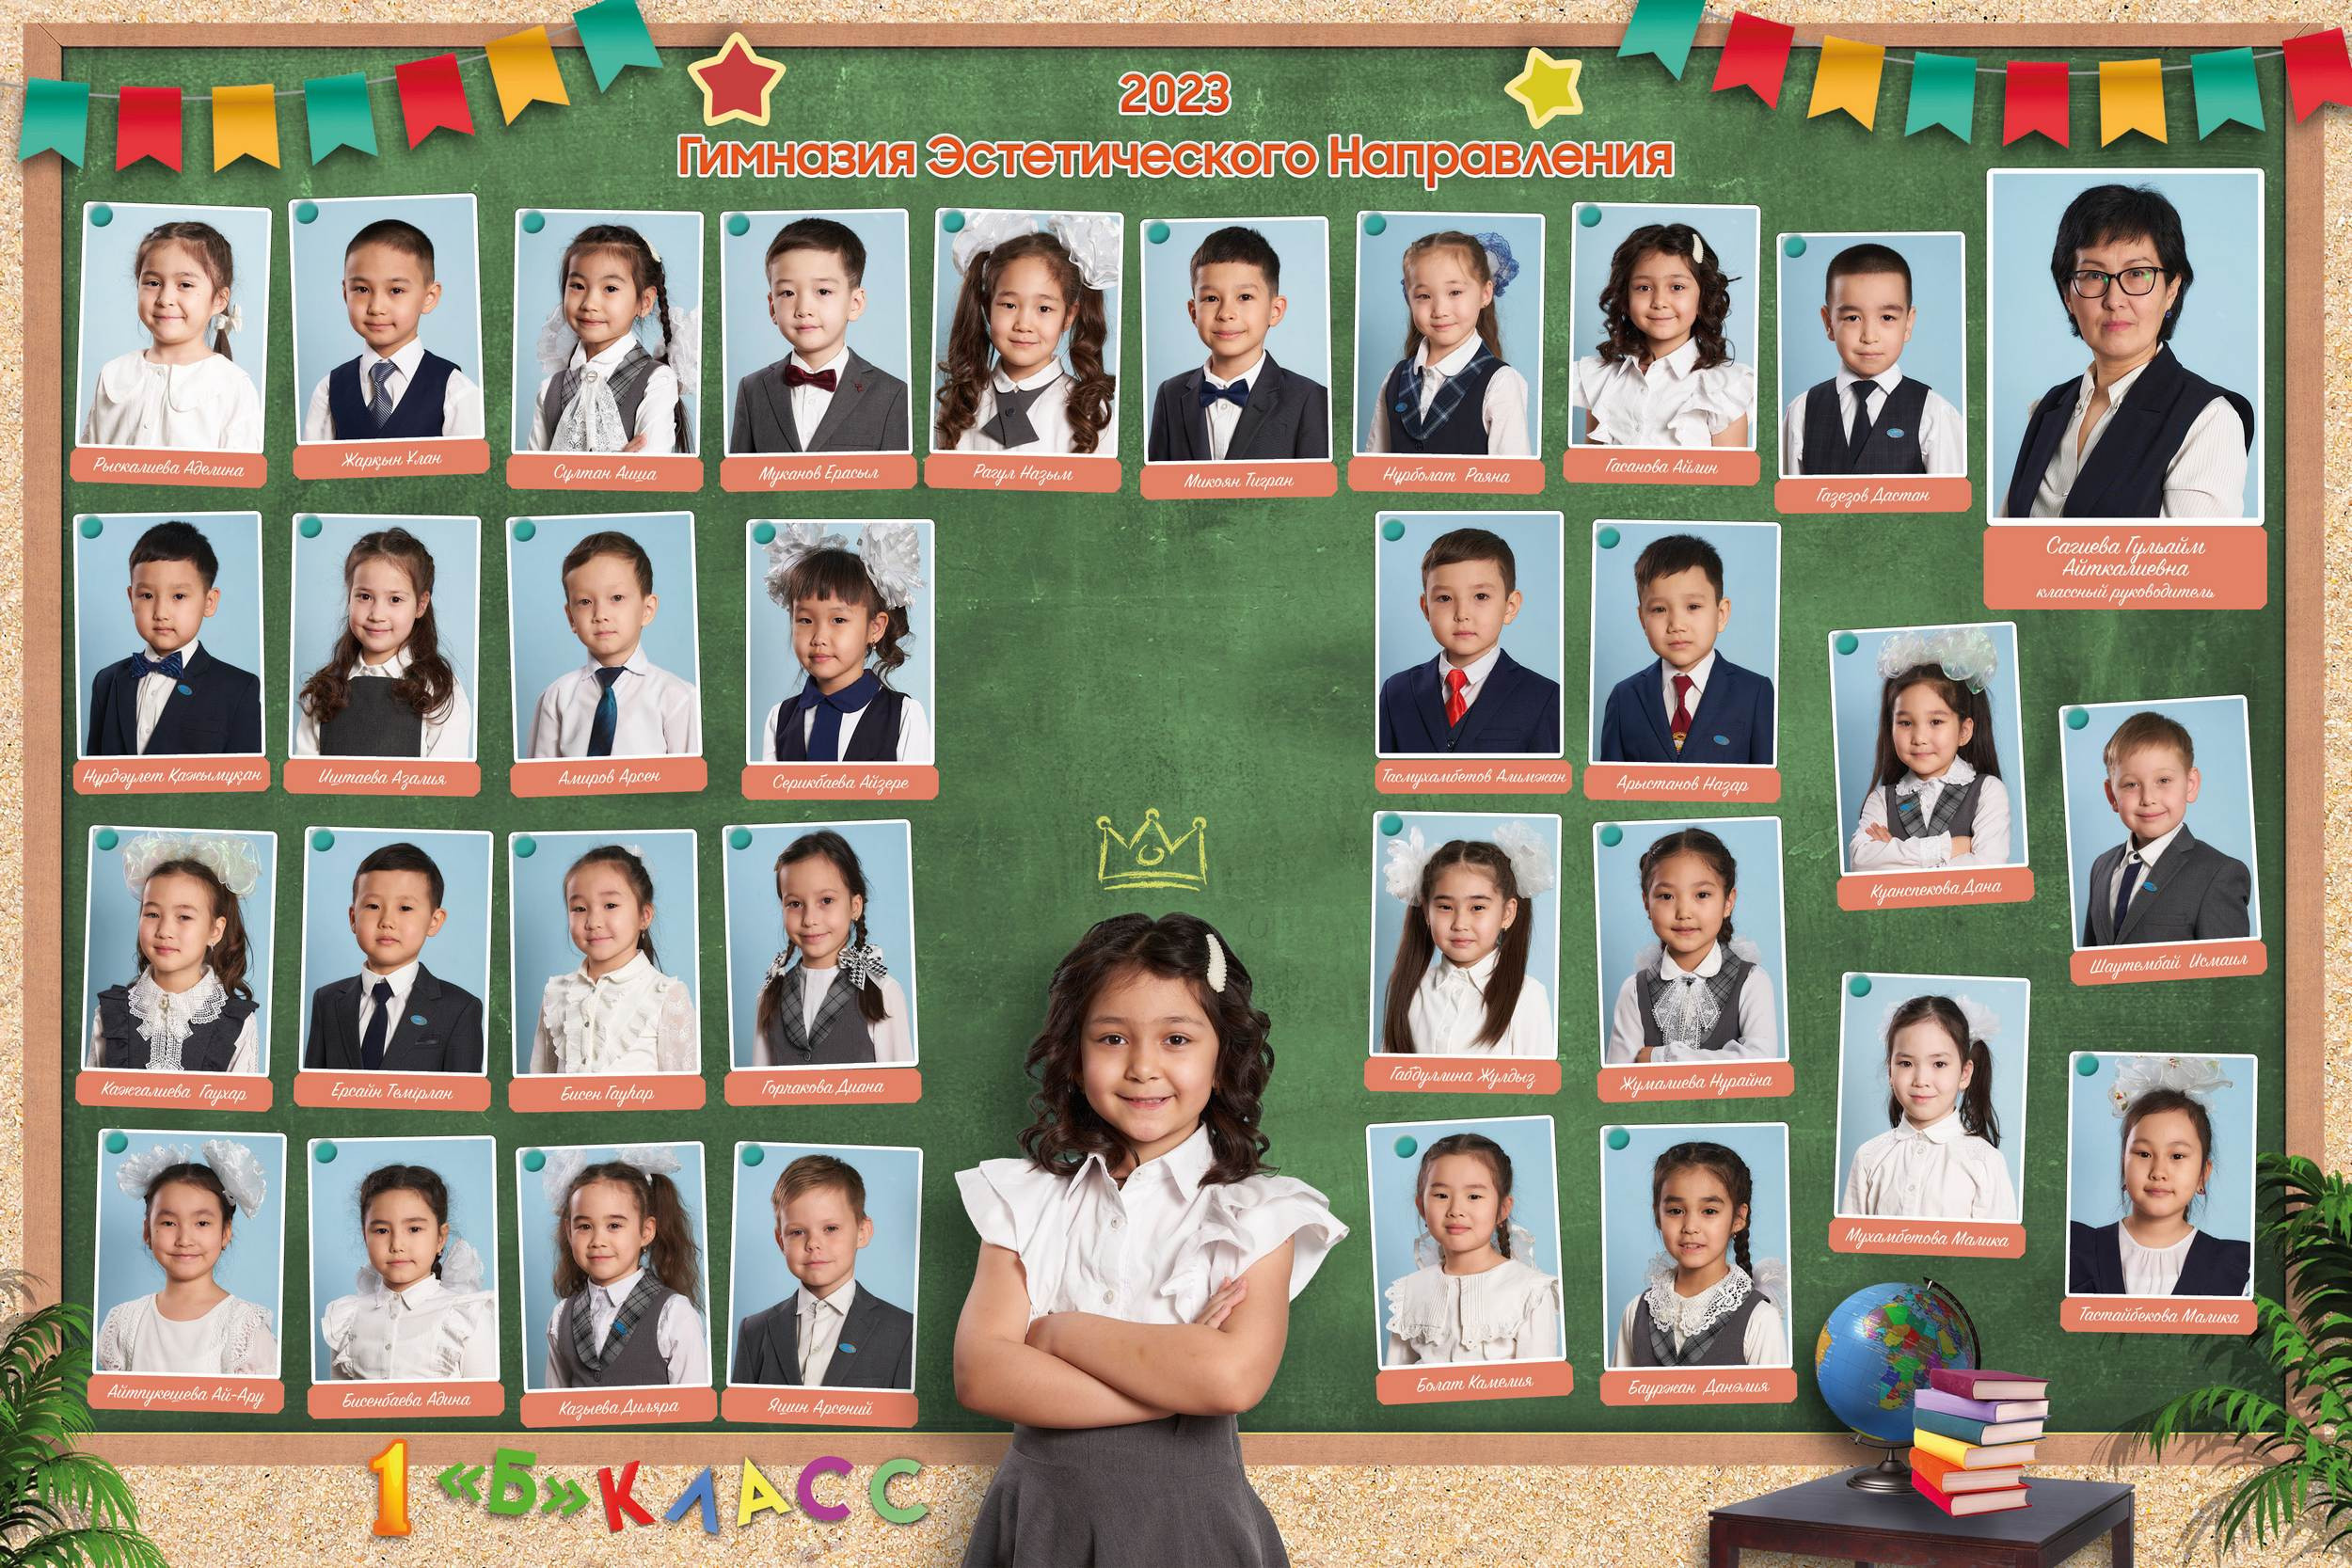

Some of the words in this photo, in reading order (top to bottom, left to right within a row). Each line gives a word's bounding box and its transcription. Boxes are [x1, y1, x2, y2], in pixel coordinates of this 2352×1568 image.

[1118, 71, 1232, 117] 2023
[676, 135, 916, 178] Гимназия
[926, 135, 1318, 179] Эстетического
[1328, 135, 1675, 190] Направления
[93, 457, 180, 474] Рыскалиева
[184, 460, 244, 476] Аделина
[342, 452, 403, 470] Жарқын
[1606, 458, 1668, 473] Гасанова
[1673, 459, 1717, 474] Айлин
[615, 466, 656, 482] Аиша
[759, 466, 821, 487] Муканов
[825, 465, 879, 483] Ерасыл
[974, 464, 1015, 485] Рагул
[1020, 465, 1073, 485] Назым
[1184, 474, 1240, 487] Микоян
[1246, 472, 1294, 490] Тигран
[1466, 467, 1510, 483] Раяна
[1817, 488, 1868, 508] Газезов
[1870, 487, 1929, 504] Дастан
[2046, 535, 2121, 555] Сагиева
[2125, 535, 2206, 563] Гульайм
[2062, 558, 2190, 577] Айткалиевна
[2036, 583, 2108, 599] классный
[2109, 582, 2216, 607] руководитель
[319, 768, 388, 785] Иштаева
[391, 770, 446, 790] Азалия
[559, 768, 614, 787] Амиров
[619, 768, 659, 786] Арсен
[773, 774, 854, 792] Серикбаева
[860, 775, 909, 795] Айзере
[1383, 768, 1492, 789] Тасмухамбетов
[1496, 768, 1565, 783] Алимжан
[1617, 775, 1699, 793] Арыстанов
[1703, 777, 1748, 797] Назар
[1870, 880, 1960, 906] Куанспекова
[1962, 879, 2002, 895] Дана
[2090, 955, 2181, 979] Шаутембай
[2189, 953, 2248, 968] Исмаил
[1391, 1067, 1472, 1088] Габдуллина
[1477, 1069, 1535, 1089] Жулдыз
[1620, 1074, 1706, 1098] Жумалиева
[1709, 1073, 1772, 1095] Нурайна
[102, 1081, 191, 1098] Кажгалиева
[199, 1085, 246, 1106] Гаухар
[331, 1083, 381, 1101] Ерсайн
[388, 1084, 453, 1102] Темірлан
[561, 1086, 602, 1101] Бисен
[606, 1084, 654, 1107] Гауһар
[762, 1079, 834, 1099] Горчакова
[835, 1079, 883, 1095] Диана
[1846, 1227, 1947, 1249] Мухамбетова
[1951, 1231, 2009, 1246] Малика
[2080, 1307, 2177, 1323] Тастайбекова
[2182, 1308, 2239, 1323] Малика
[1417, 1378, 1464, 1392] Болат
[1469, 1375, 1534, 1388] Камелия
[1629, 1380, 1694, 1402] Бауржан
[212, 1386, 264, 1409] Ай-Ару
[342, 1392, 421, 1407] Бисенбаева
[427, 1392, 470, 1405] Адина
[768, 1398, 808, 1415] Яшин
[813, 1400, 873, 1418] Арсений
[559, 1400, 619, 1421] Казыева
[621, 1399, 678, 1416] Диляра
[368, 1438, 412, 1537] 1
[437, 1447, 591, 1516] «Б»
[596, 1454, 930, 1535] КЛАСС
